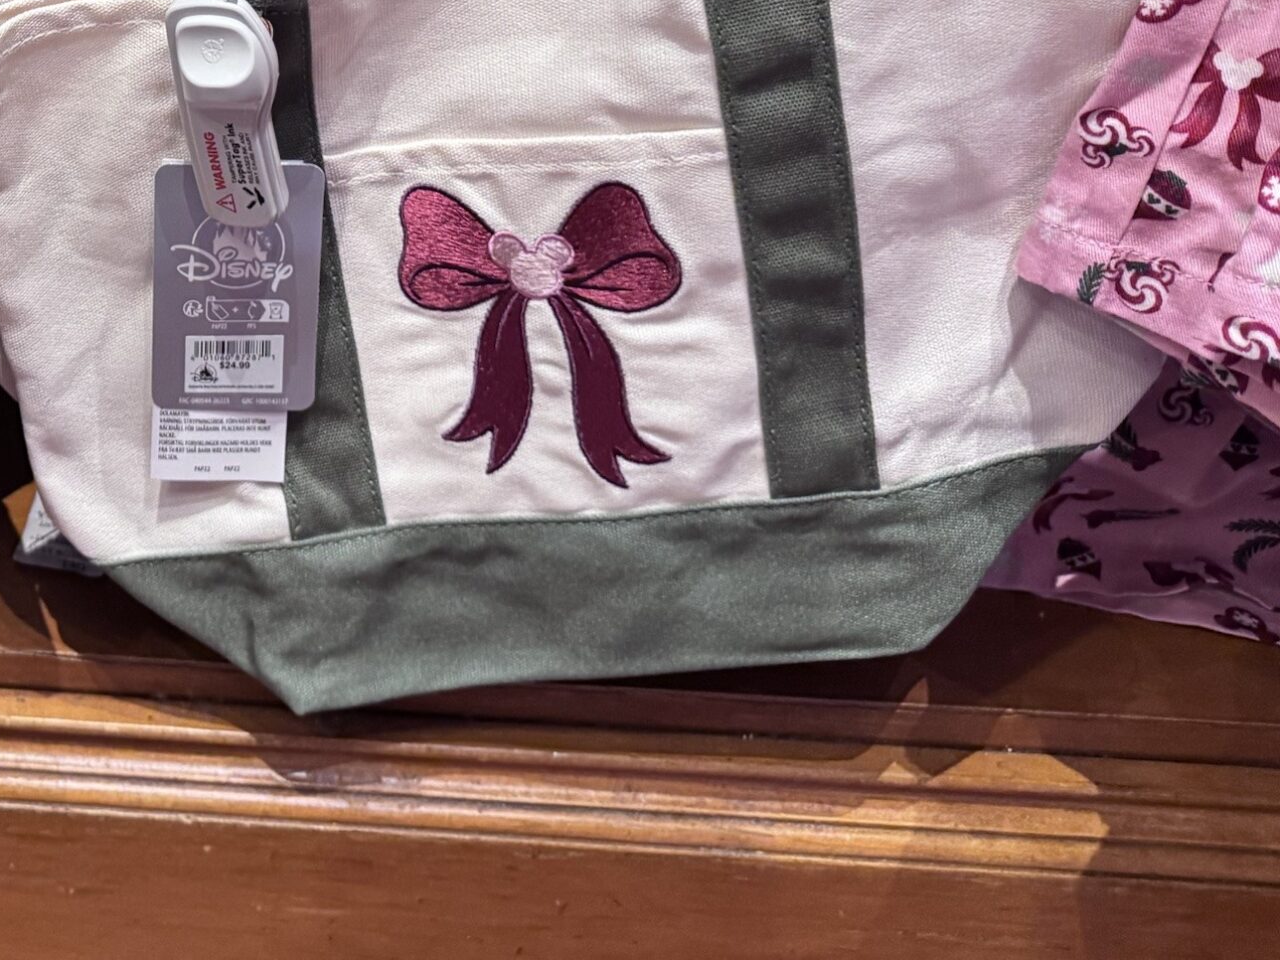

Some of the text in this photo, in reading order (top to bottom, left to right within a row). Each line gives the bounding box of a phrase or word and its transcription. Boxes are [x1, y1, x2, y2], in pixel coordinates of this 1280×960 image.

[225, 123, 235, 137] Ink
[204, 132, 227, 190] WARNING
[225, 151, 237, 184] TAMPERING
[220, 361, 250, 369] $24.99
